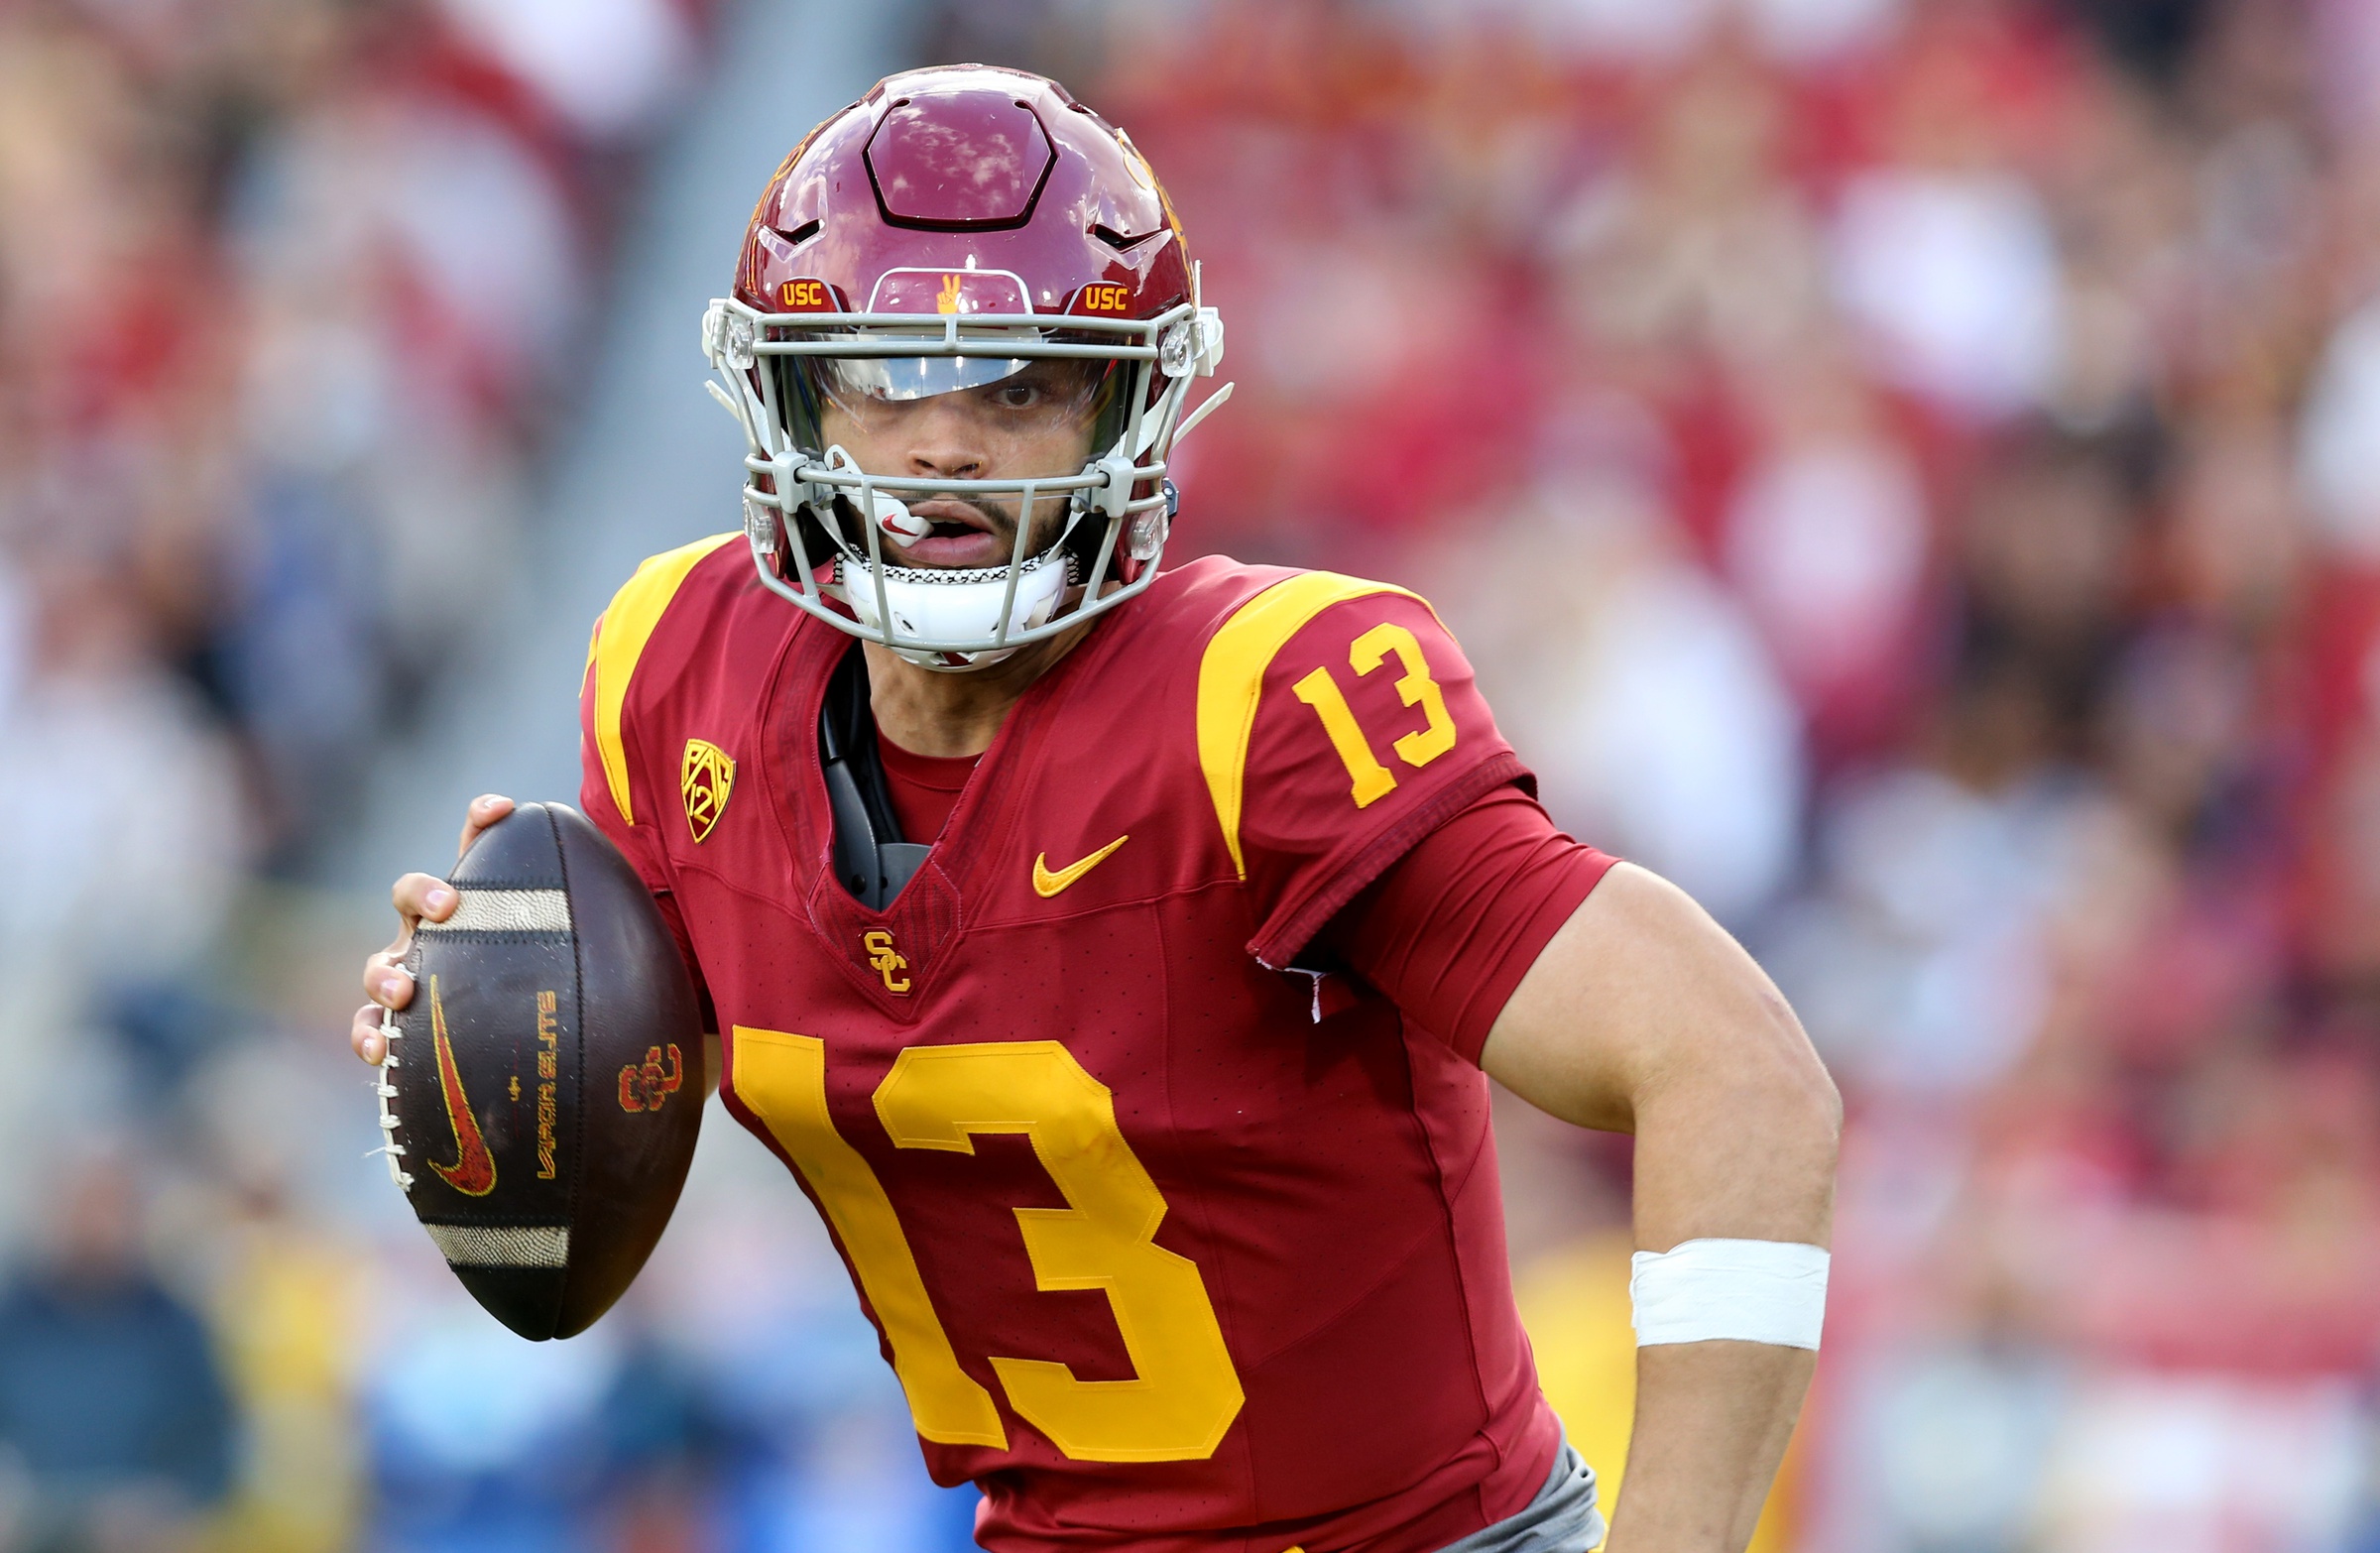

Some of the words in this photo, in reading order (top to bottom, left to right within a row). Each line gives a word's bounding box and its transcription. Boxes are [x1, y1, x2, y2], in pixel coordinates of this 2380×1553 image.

[782, 283, 822, 305] USC
[1086, 287, 1128, 309] USC
[1291, 622, 1457, 809] 13
[683, 743, 729, 813] PAC
[688, 782, 713, 825] 12
[864, 931, 910, 992] SC
[537, 990, 557, 1080] ELITE
[537, 1082, 556, 1179] VAPOR
[732, 1024, 1245, 1462] 13
